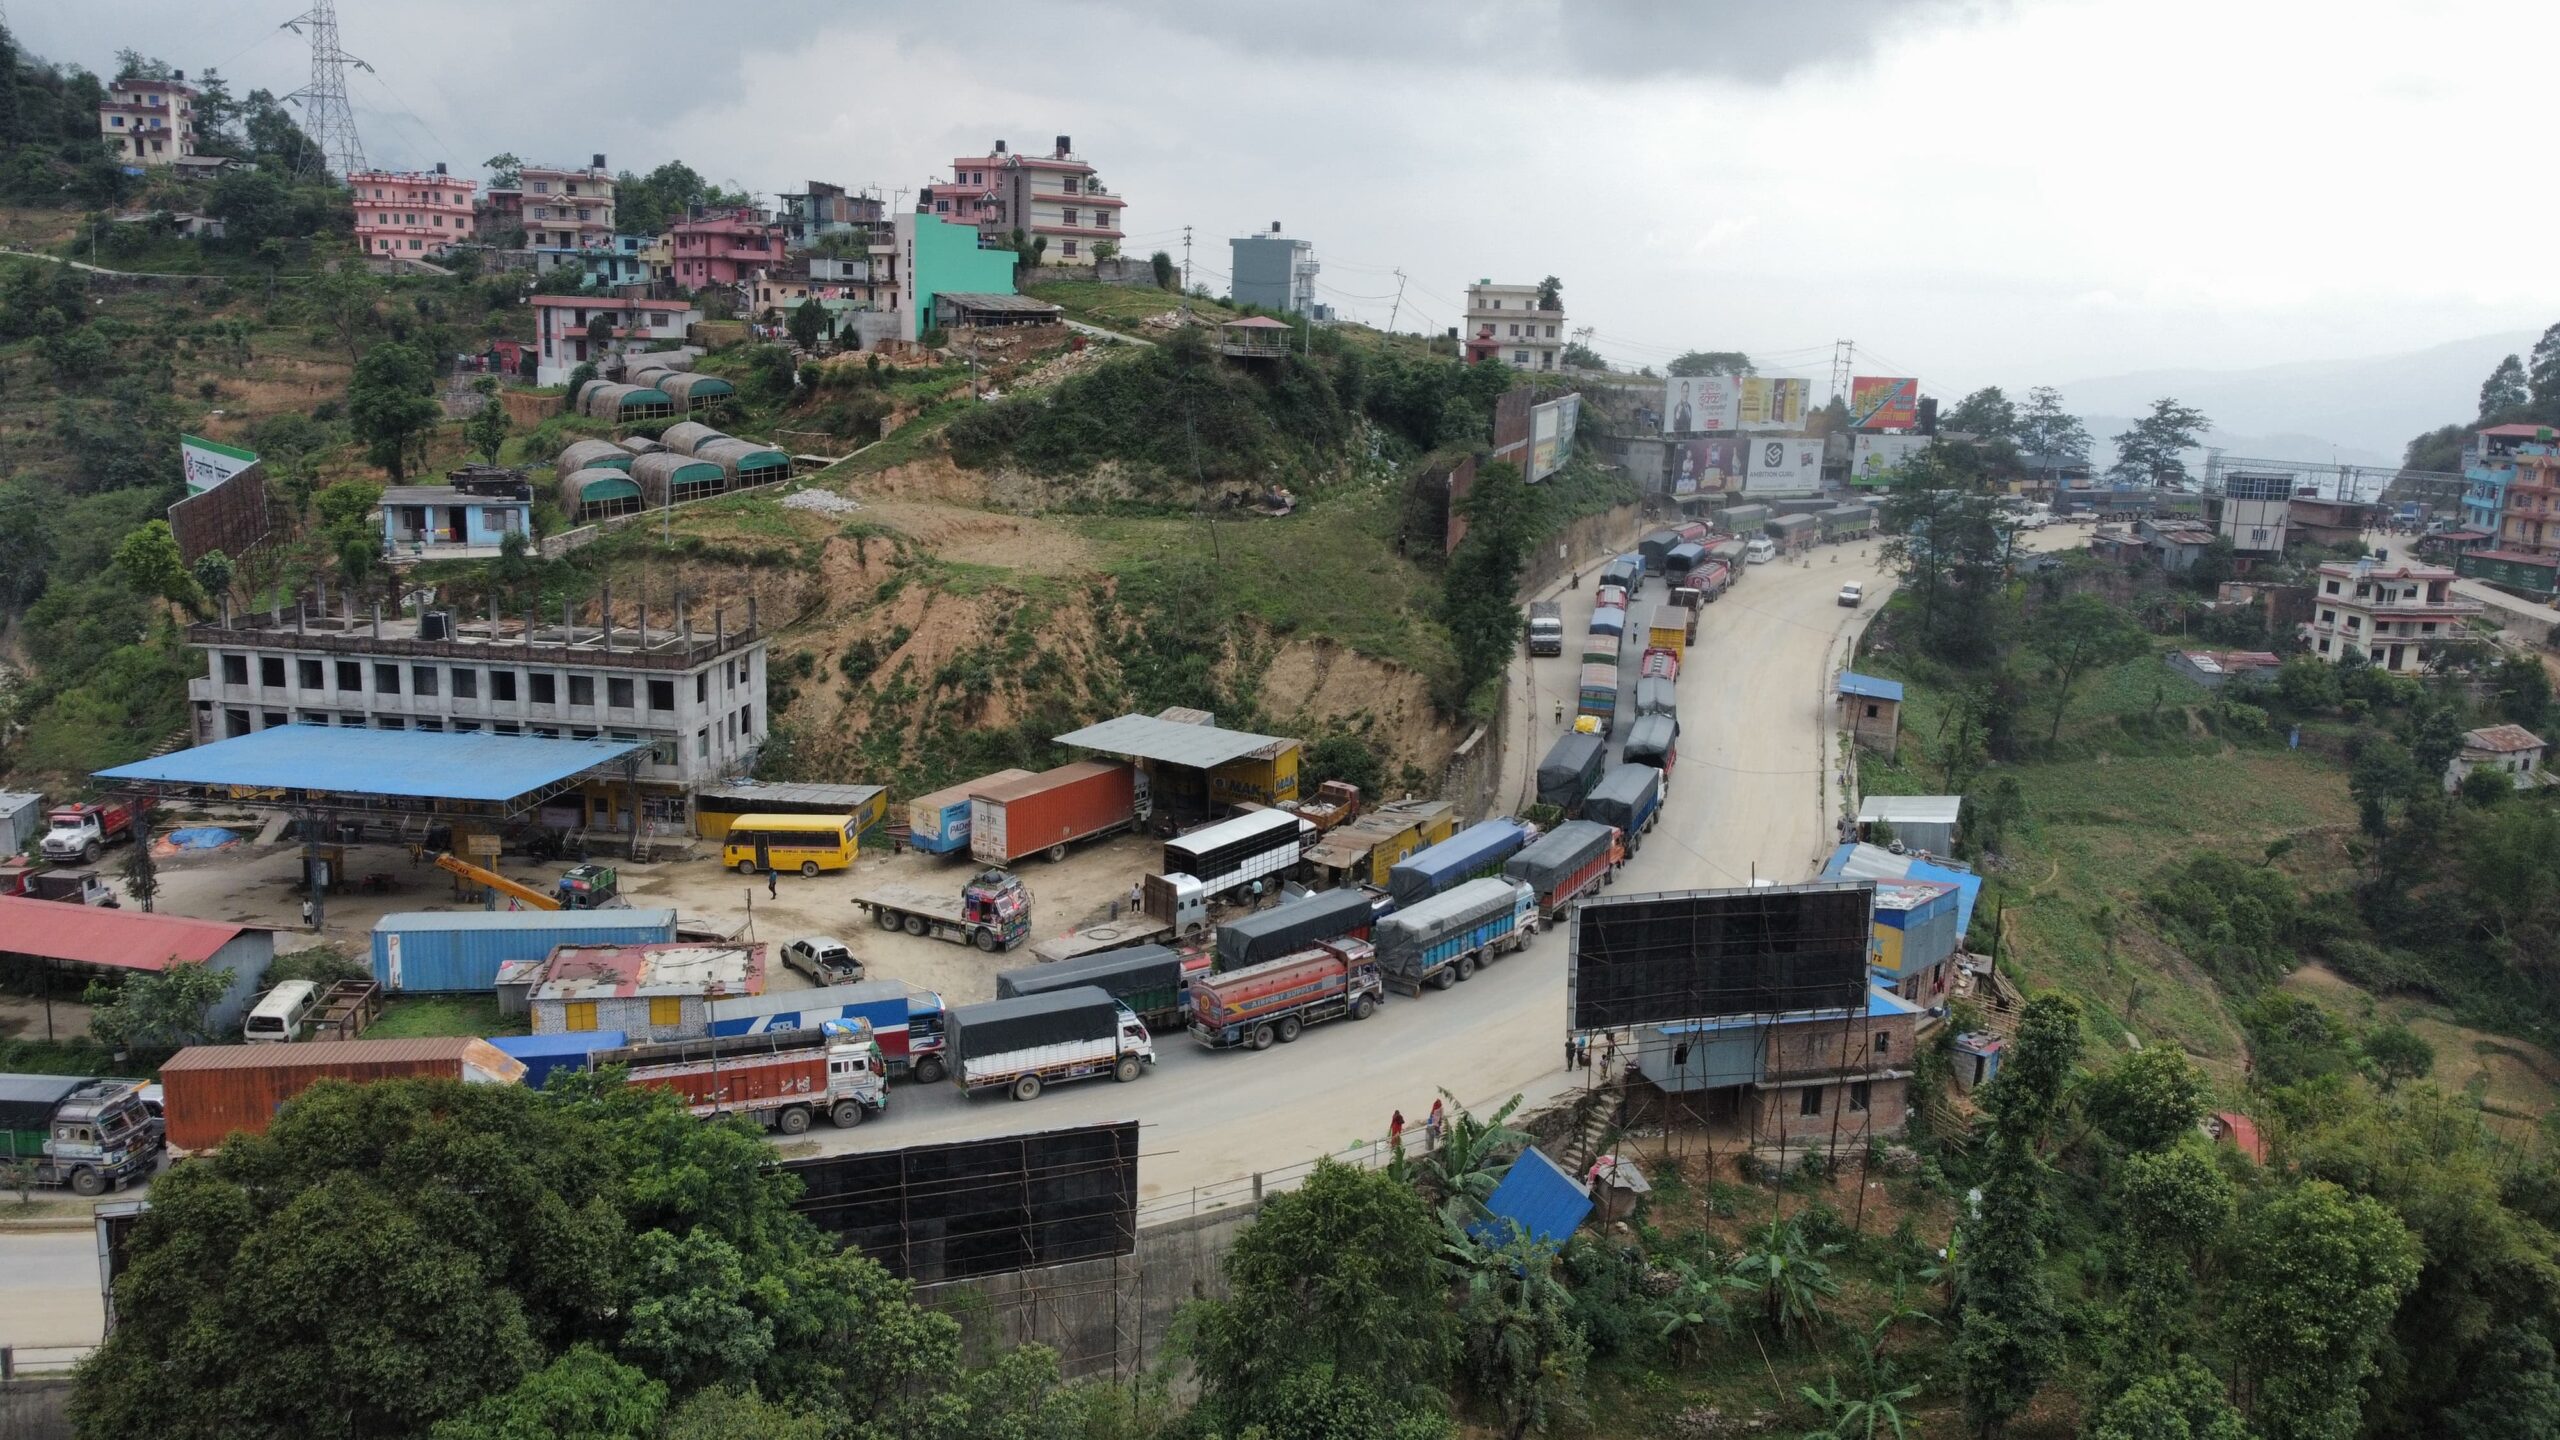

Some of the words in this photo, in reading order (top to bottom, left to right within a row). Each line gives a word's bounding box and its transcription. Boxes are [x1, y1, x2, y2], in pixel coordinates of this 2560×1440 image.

[1750, 470, 1778, 478] AMBITION
[1251, 993, 1284, 1008] AIRPORT
[1286, 984, 1315, 998] SUPPLY
